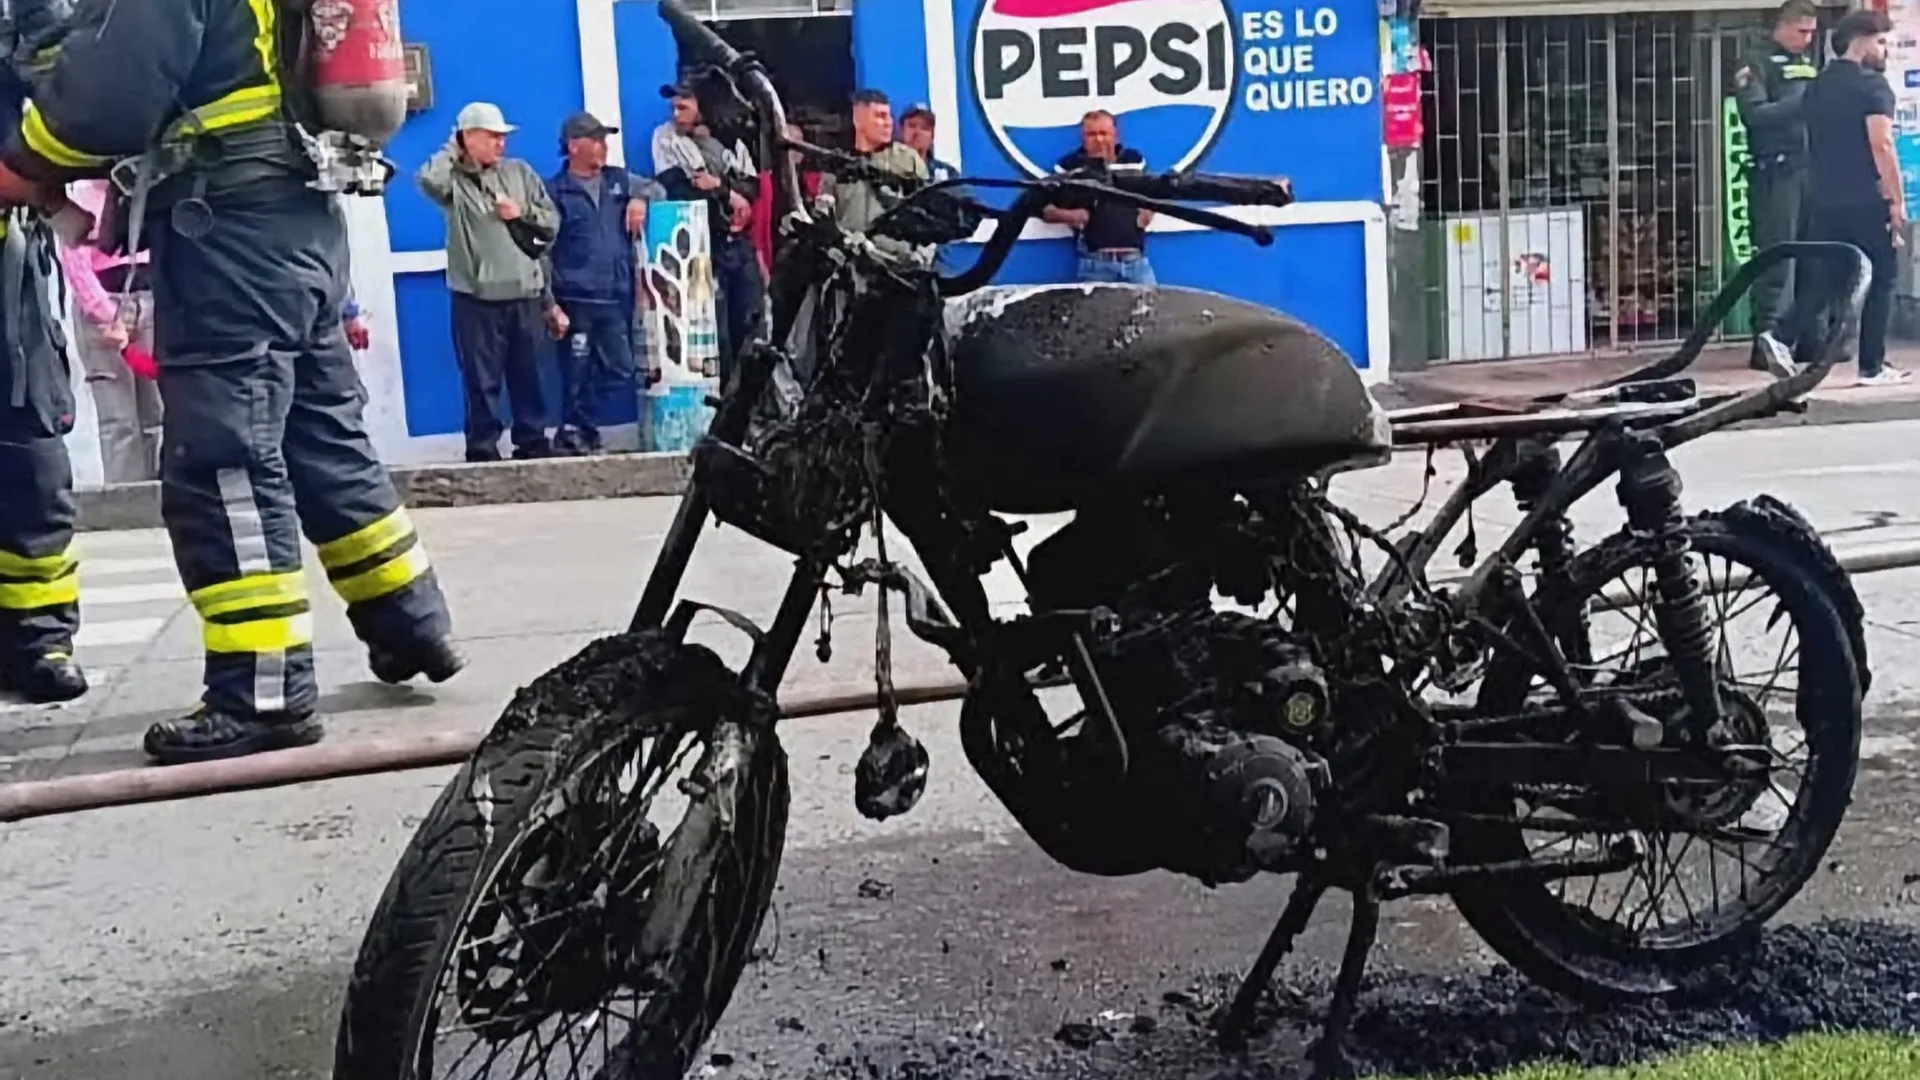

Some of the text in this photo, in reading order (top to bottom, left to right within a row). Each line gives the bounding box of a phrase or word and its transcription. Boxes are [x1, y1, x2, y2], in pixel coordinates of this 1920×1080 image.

[1242, 8, 1338, 40] ES LO
[982, 21, 1226, 99] PEPSI
[1243, 45, 1314, 77] QUE
[1245, 76, 1373, 112] QUIERO
